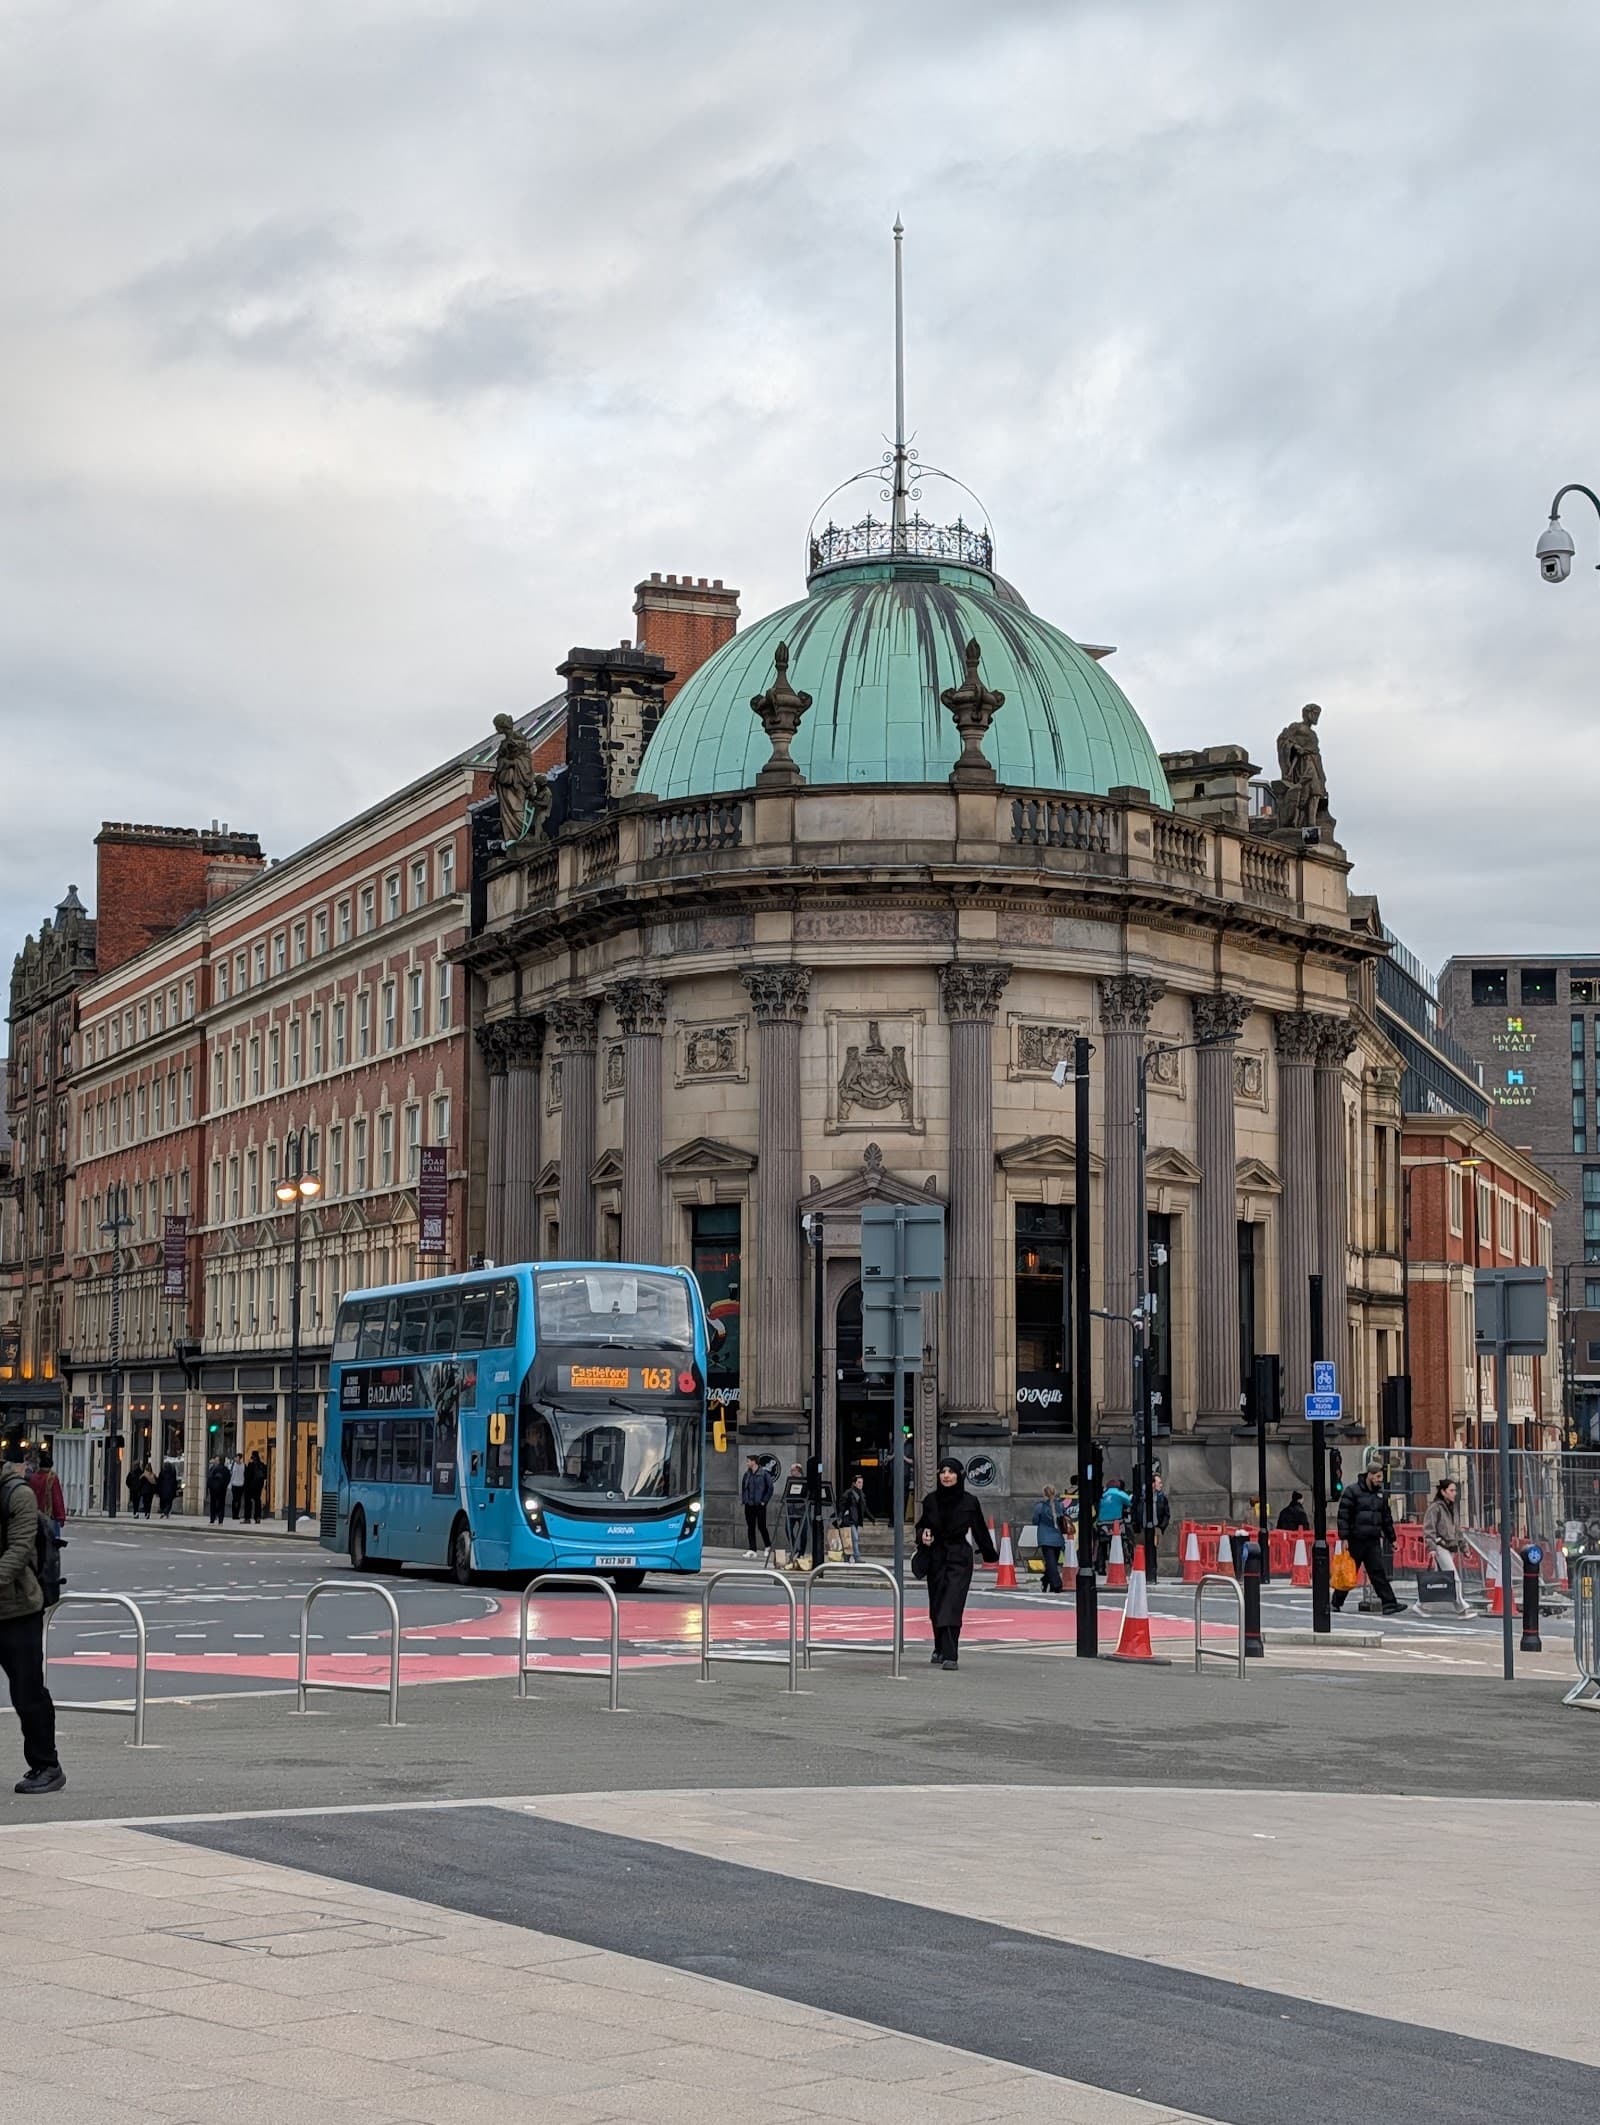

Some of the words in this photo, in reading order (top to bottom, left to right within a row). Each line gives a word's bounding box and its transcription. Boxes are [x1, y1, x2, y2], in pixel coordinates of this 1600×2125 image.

[1492, 1034, 1537, 1043] HYATT
[1498, 1044, 1532, 1052] PLACE
[1493, 1087, 1537, 1096] HYATT
[1499, 1096, 1532, 1105] house
[571, 1365, 629, 1378] Castleford
[641, 1367, 671, 1389] 163
[367, 1384, 414, 1404] BADLANDS
[606, 1526, 636, 1535] ARRIVA
